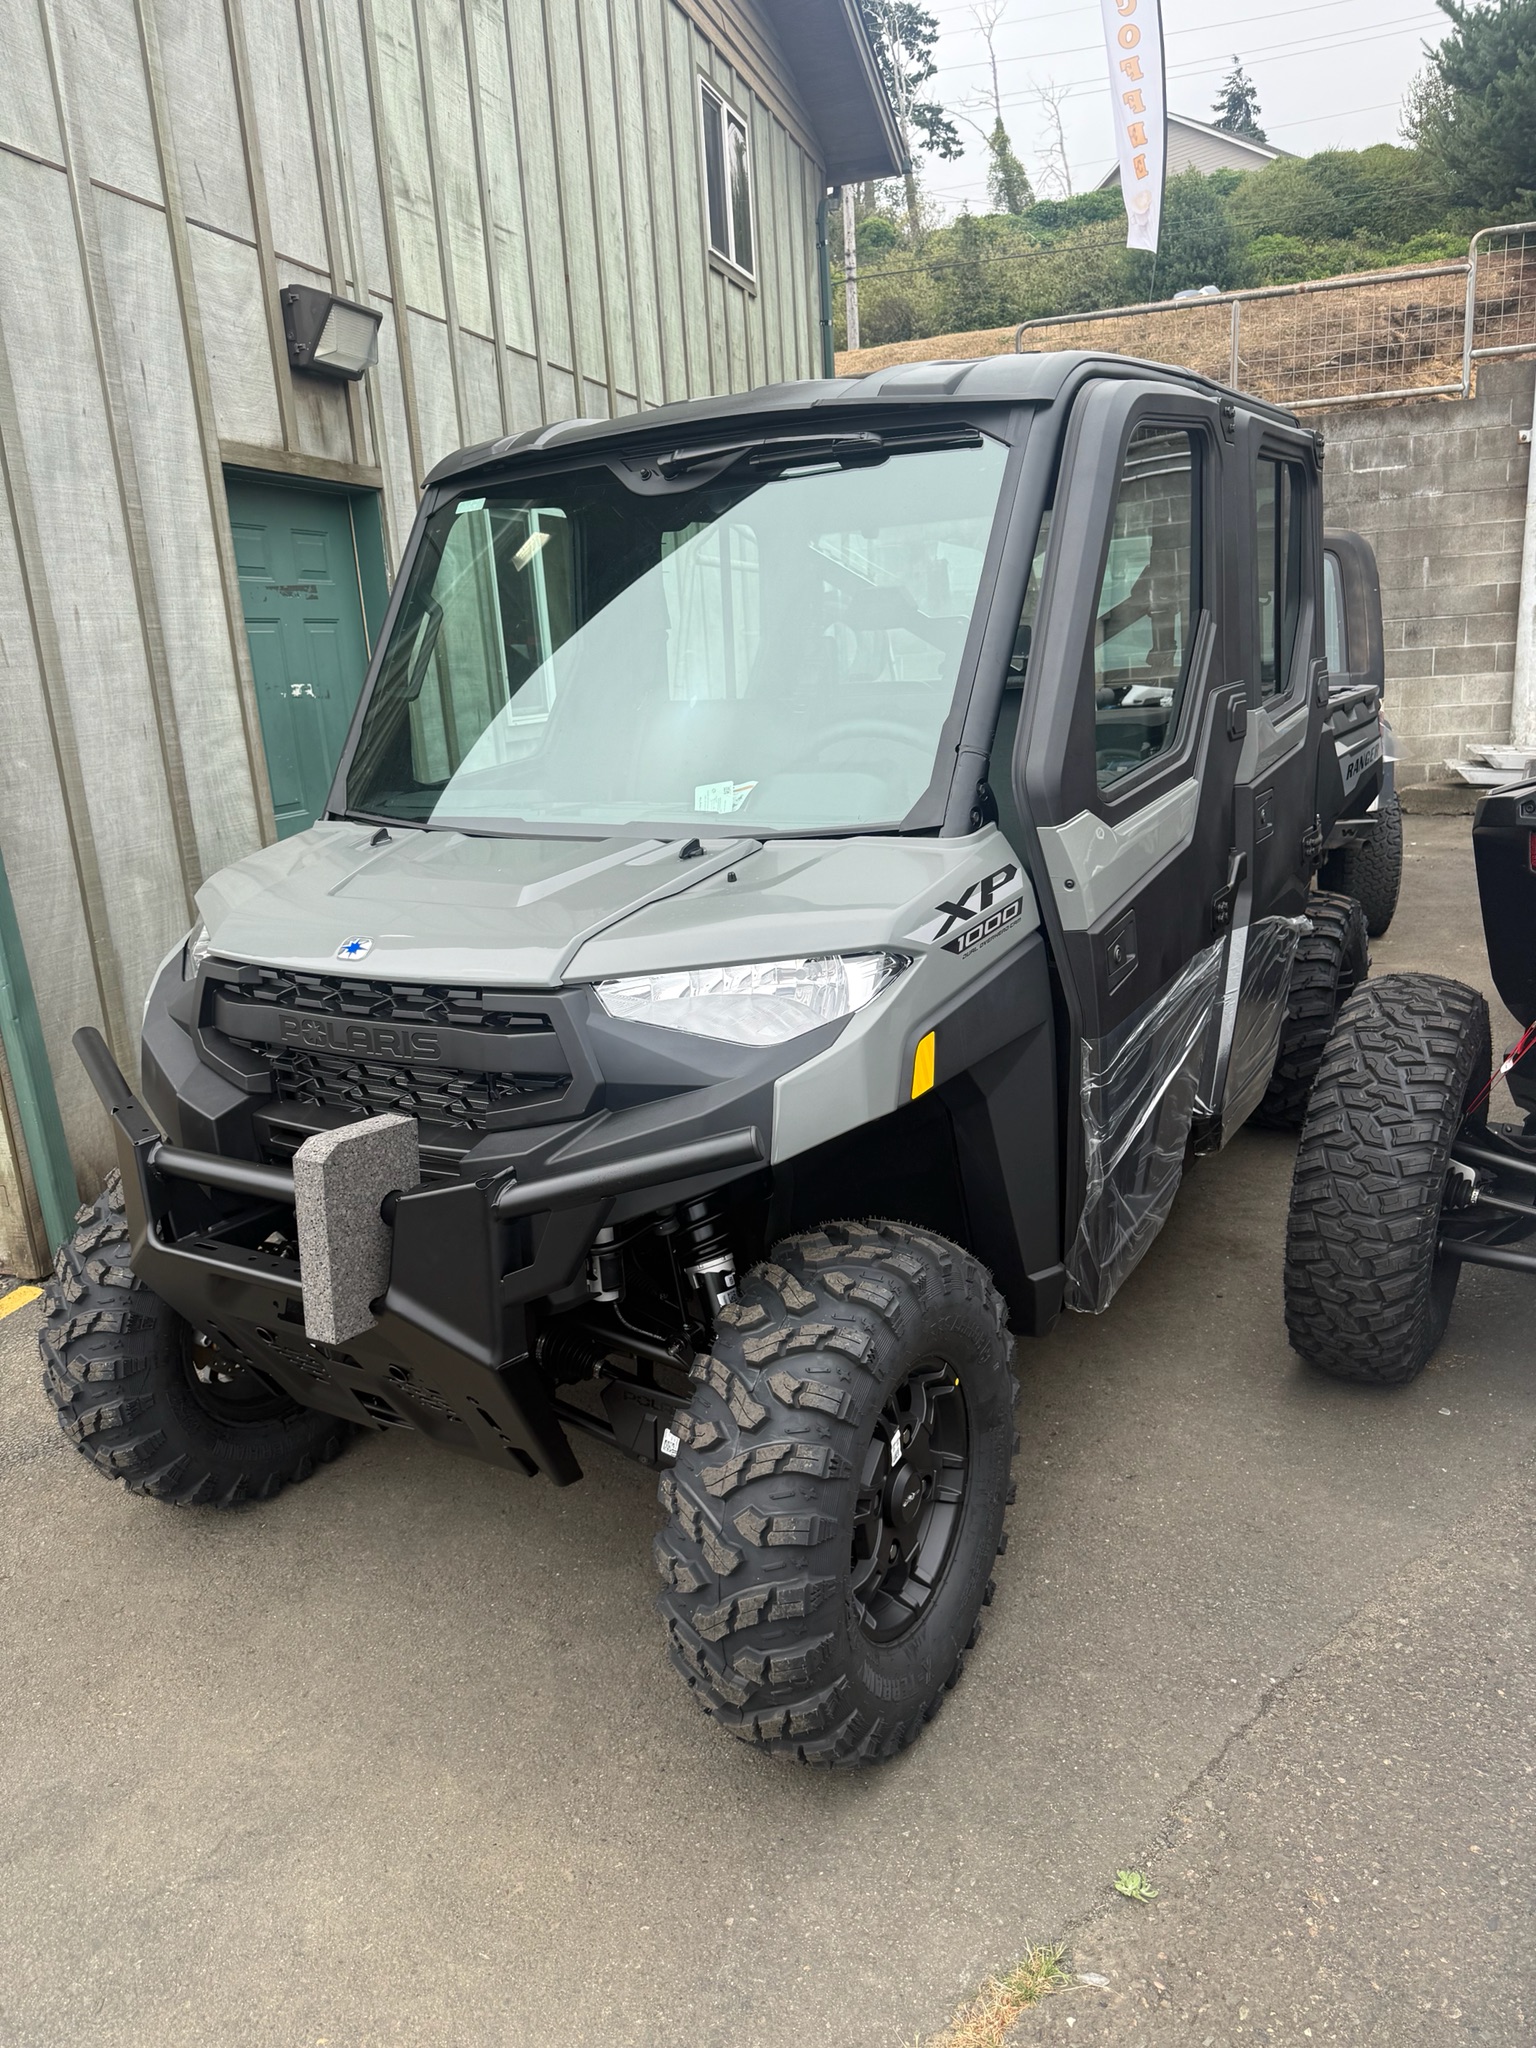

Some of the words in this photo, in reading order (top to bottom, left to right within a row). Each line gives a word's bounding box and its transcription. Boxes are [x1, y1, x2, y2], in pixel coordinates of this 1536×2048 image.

[932, 863, 1018, 941] XP
[958, 900, 1019, 952] 1000
[962, 947, 978, 960] DUAL
[278, 1014, 442, 1061] POLARIS
